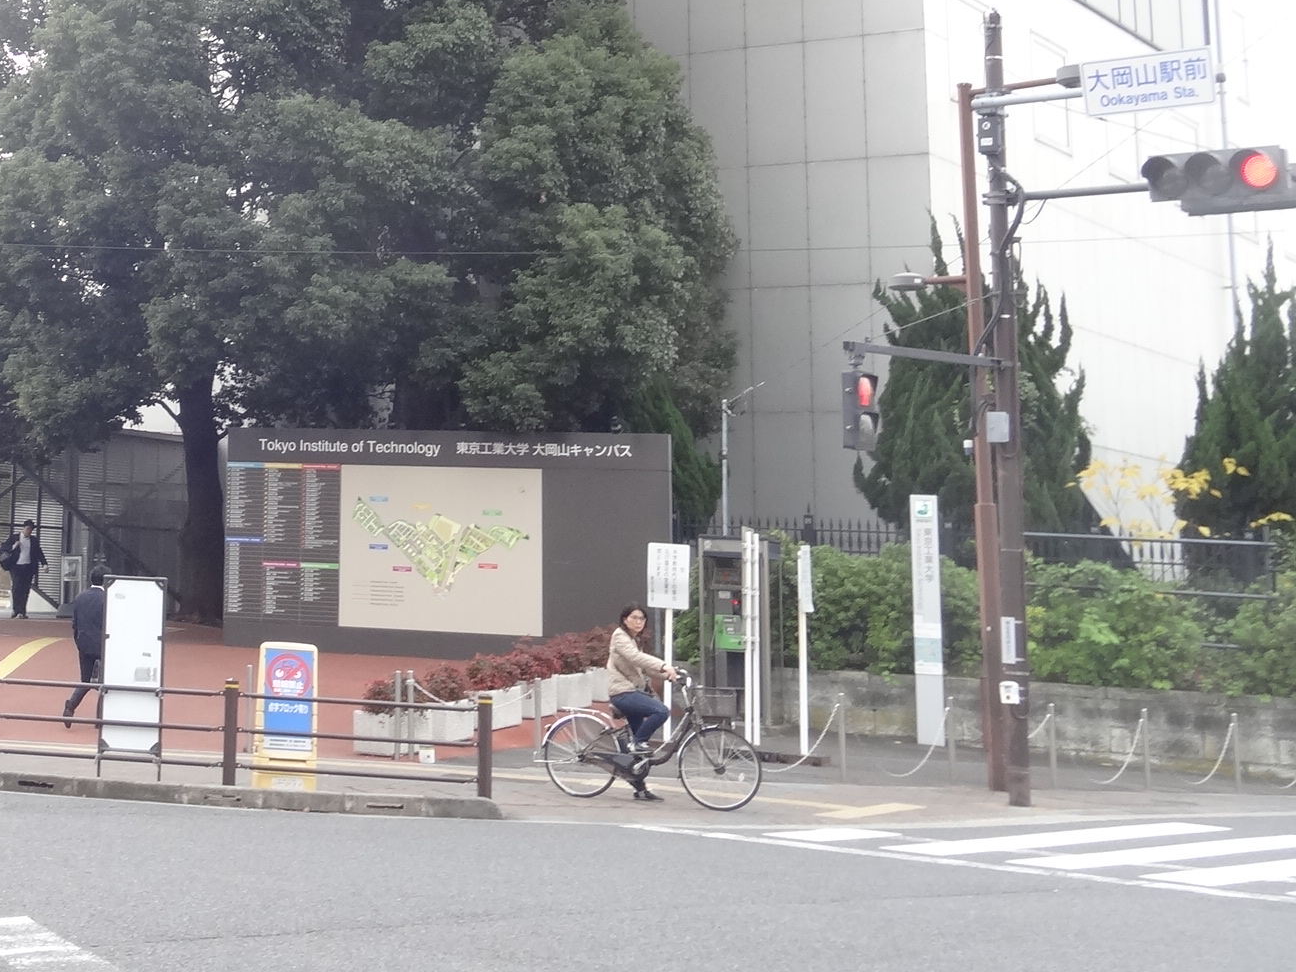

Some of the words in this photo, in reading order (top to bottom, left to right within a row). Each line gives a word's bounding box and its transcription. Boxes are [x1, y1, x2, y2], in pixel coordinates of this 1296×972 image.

[1087, 57, 1206, 92] 大岡山駅前
[1100, 91, 1168, 107] Ookayama
[1173, 86, 1200, 99] Sta.
[259, 438, 297, 454] Tokyo
[299, 439, 349, 453] Institute
[351, 440, 364, 453] of
[367, 440, 442, 457] Technology
[456, 441, 530, 455] 東京工業大学
[532, 443, 633, 457] 大岡山キャンパス
